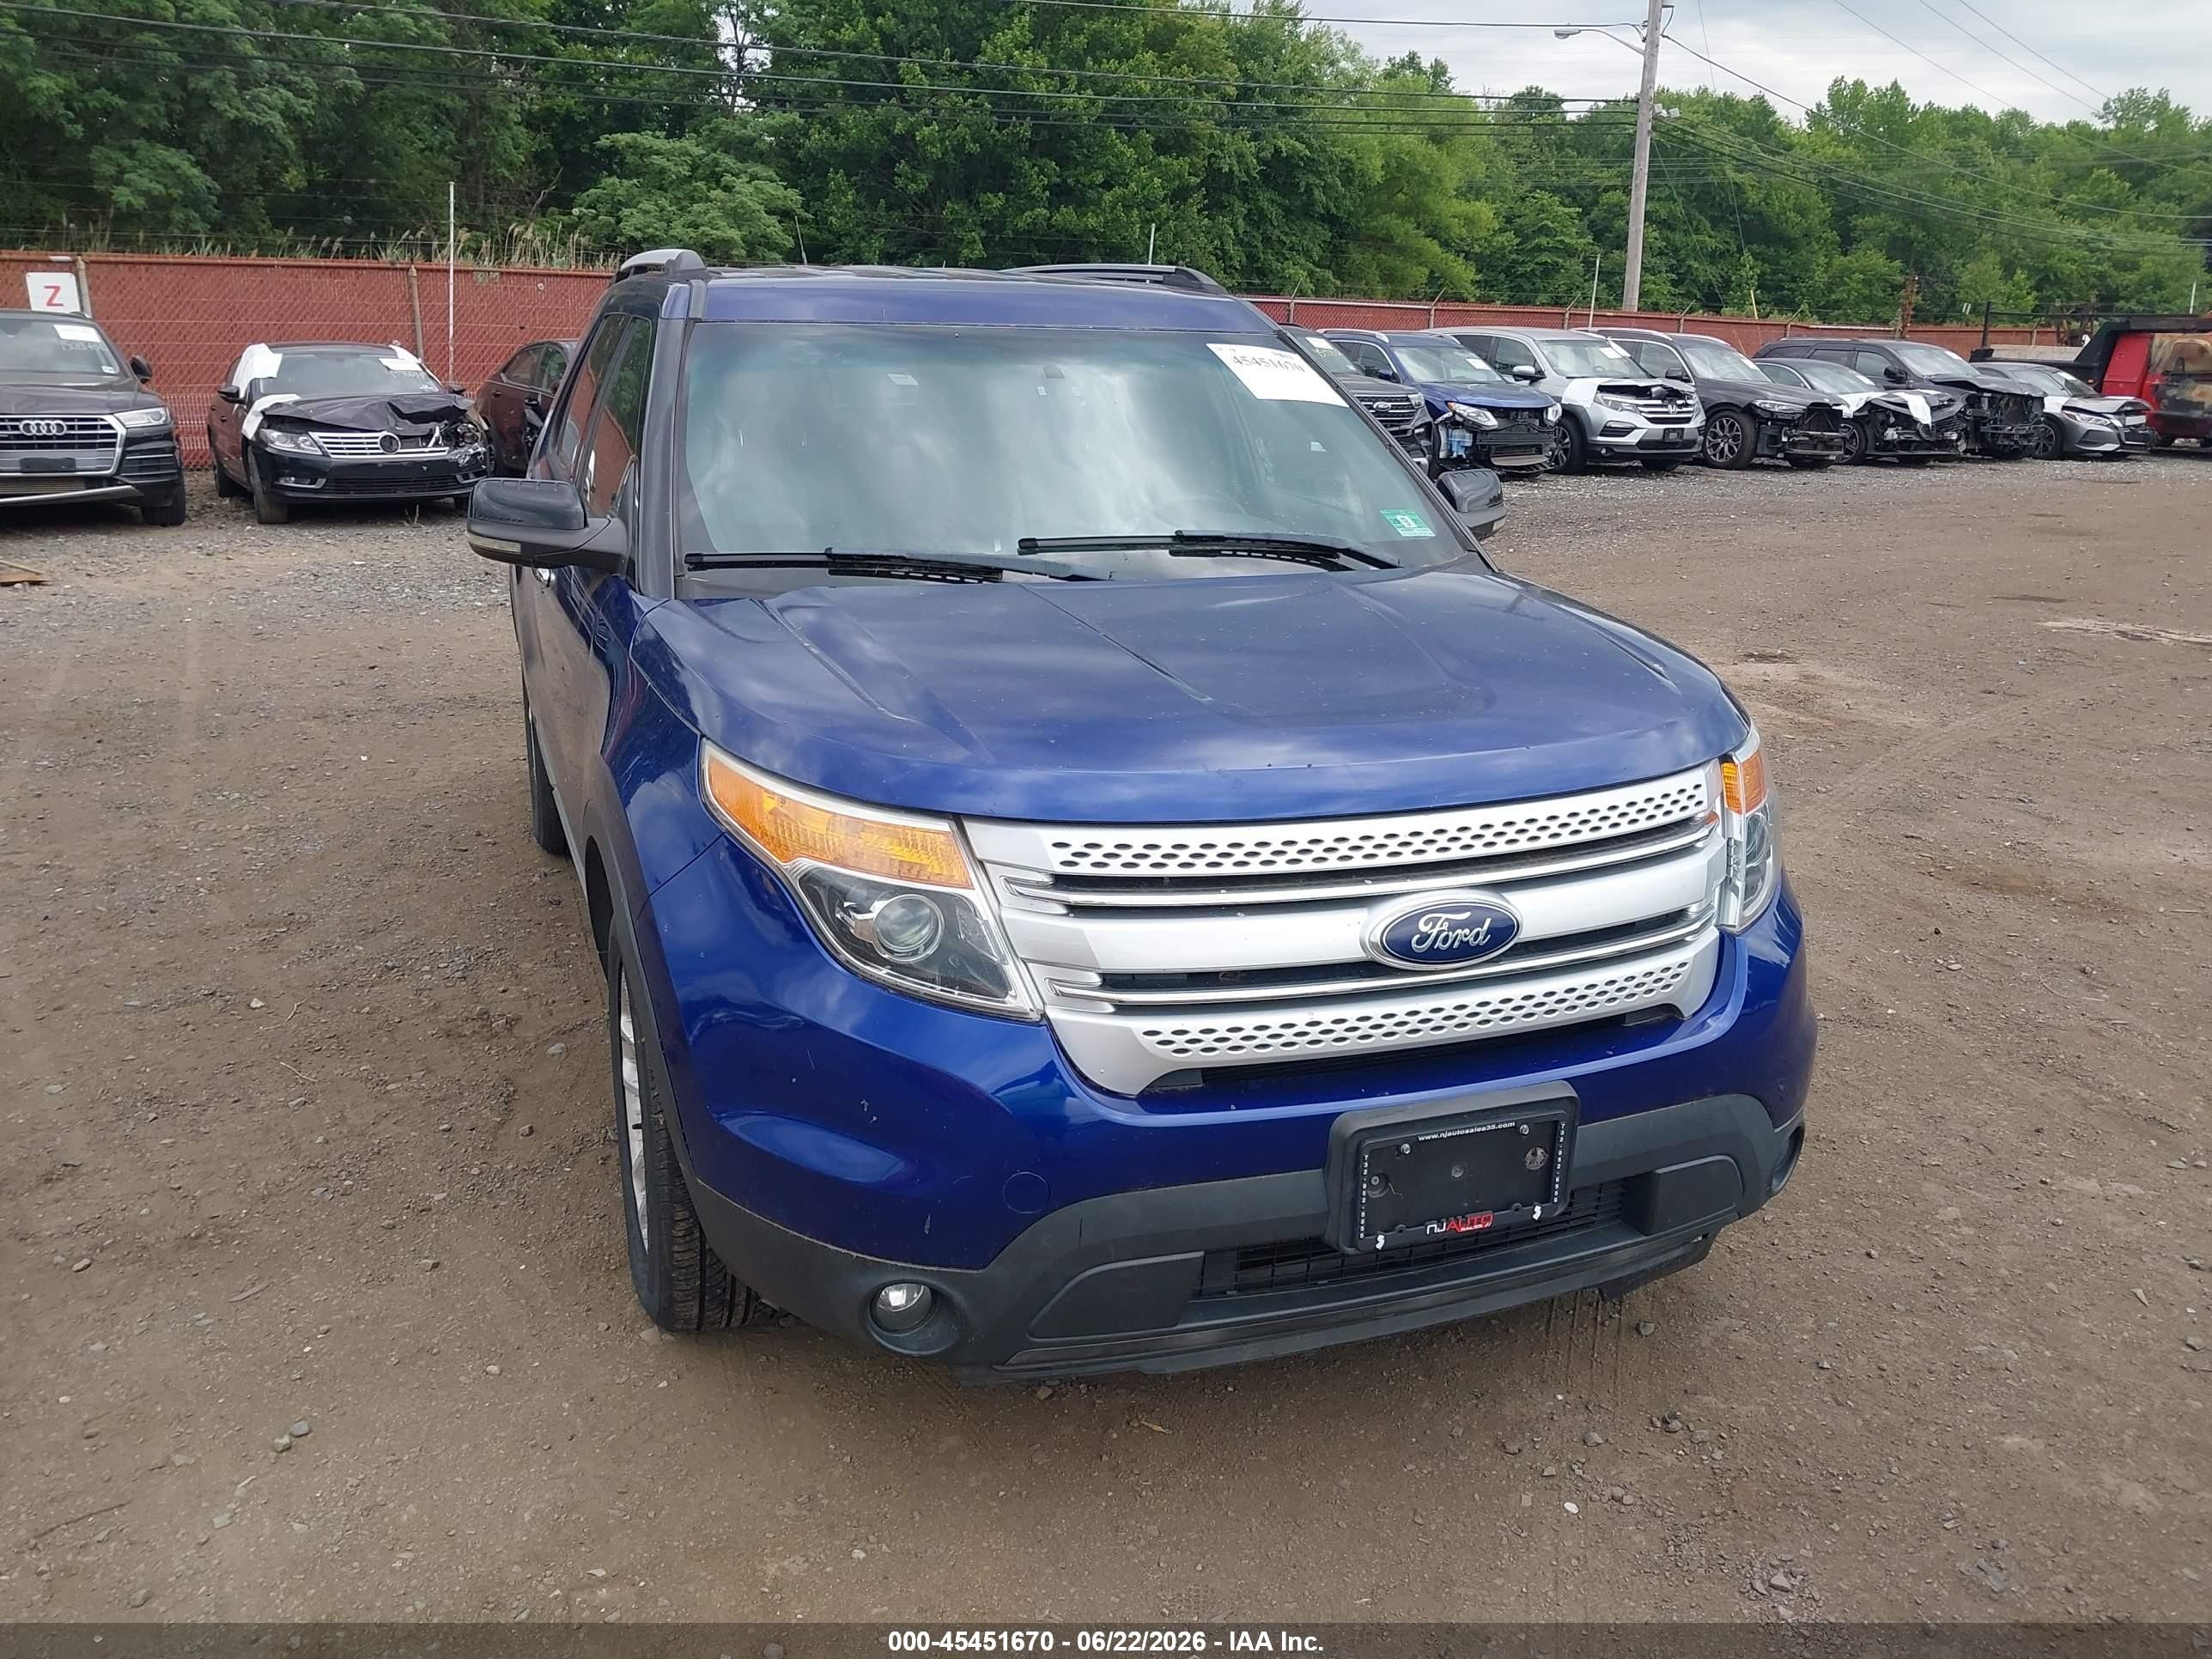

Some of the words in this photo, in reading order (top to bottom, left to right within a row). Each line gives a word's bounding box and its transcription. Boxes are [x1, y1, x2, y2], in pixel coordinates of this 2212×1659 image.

[44, 285, 64, 307] Z
[1411, 910, 1492, 953] Ford
[1417, 1121, 1516, 1142] www.njautosales35.com
